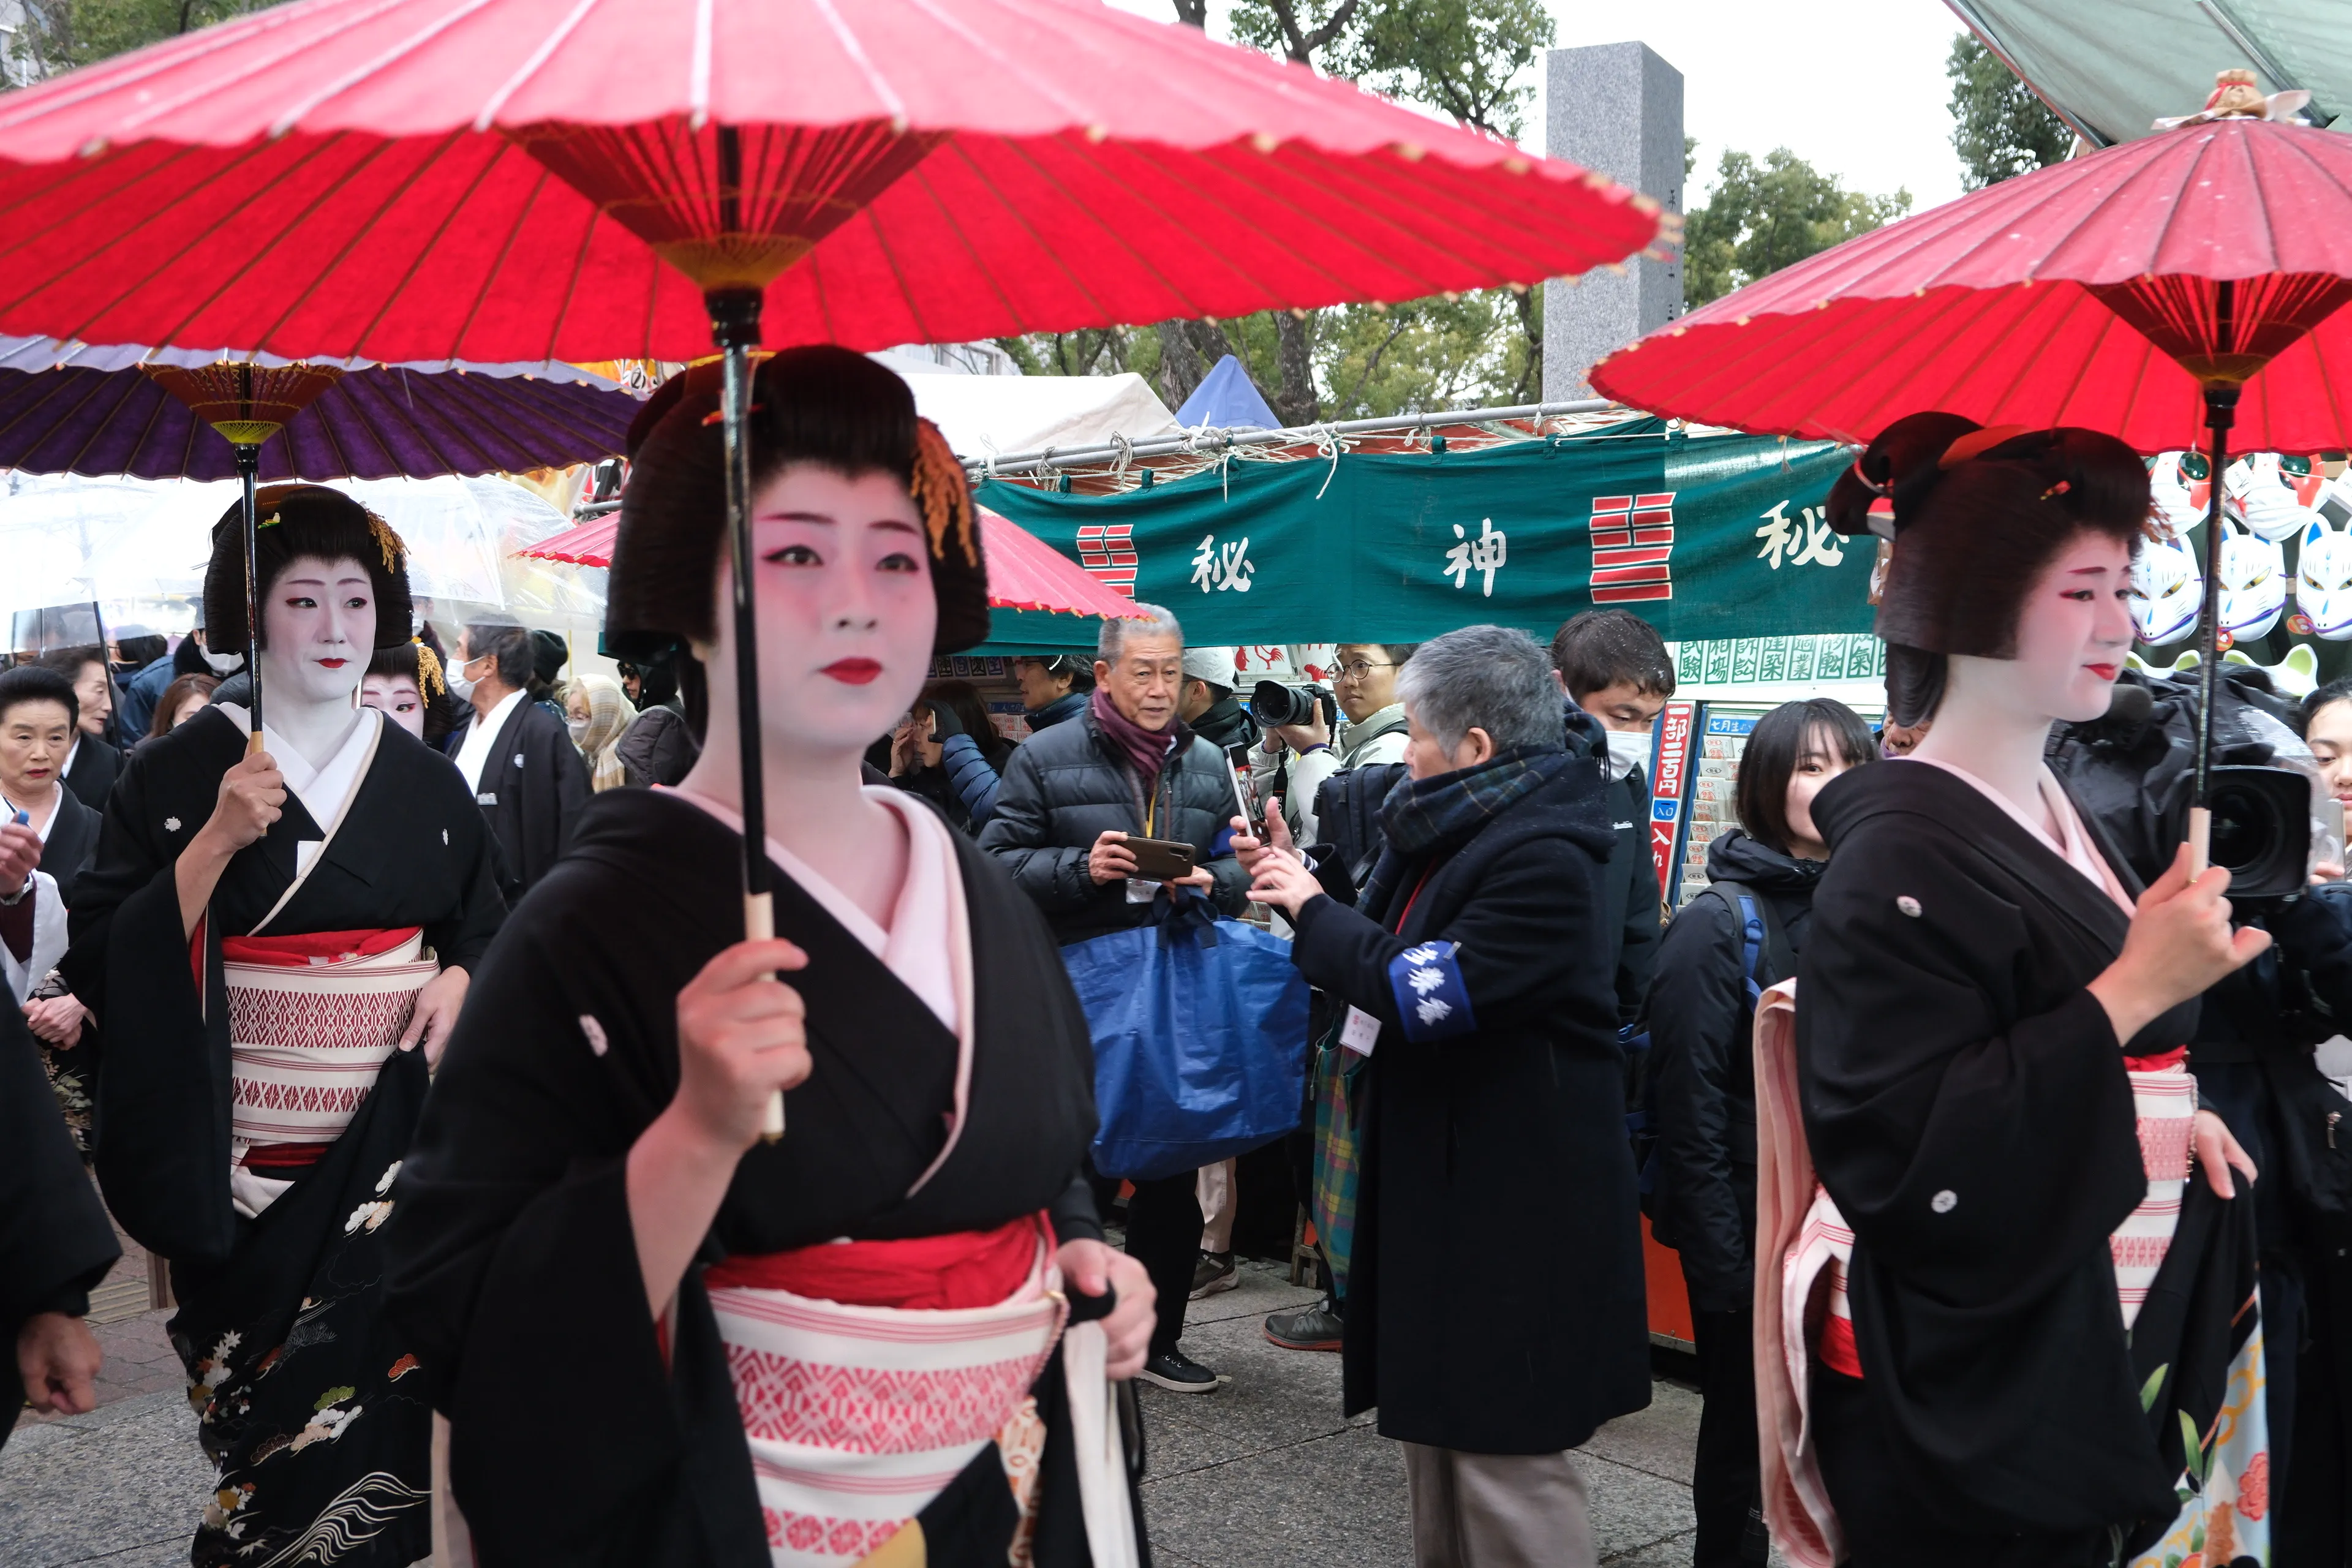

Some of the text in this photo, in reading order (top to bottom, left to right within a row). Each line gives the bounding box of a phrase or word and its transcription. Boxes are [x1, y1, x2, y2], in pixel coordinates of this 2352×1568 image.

[1190, 535, 1256, 594] 秘
[1443, 500, 1850, 597] 神 秘
[1658, 707, 1690, 795] 一部二百円
